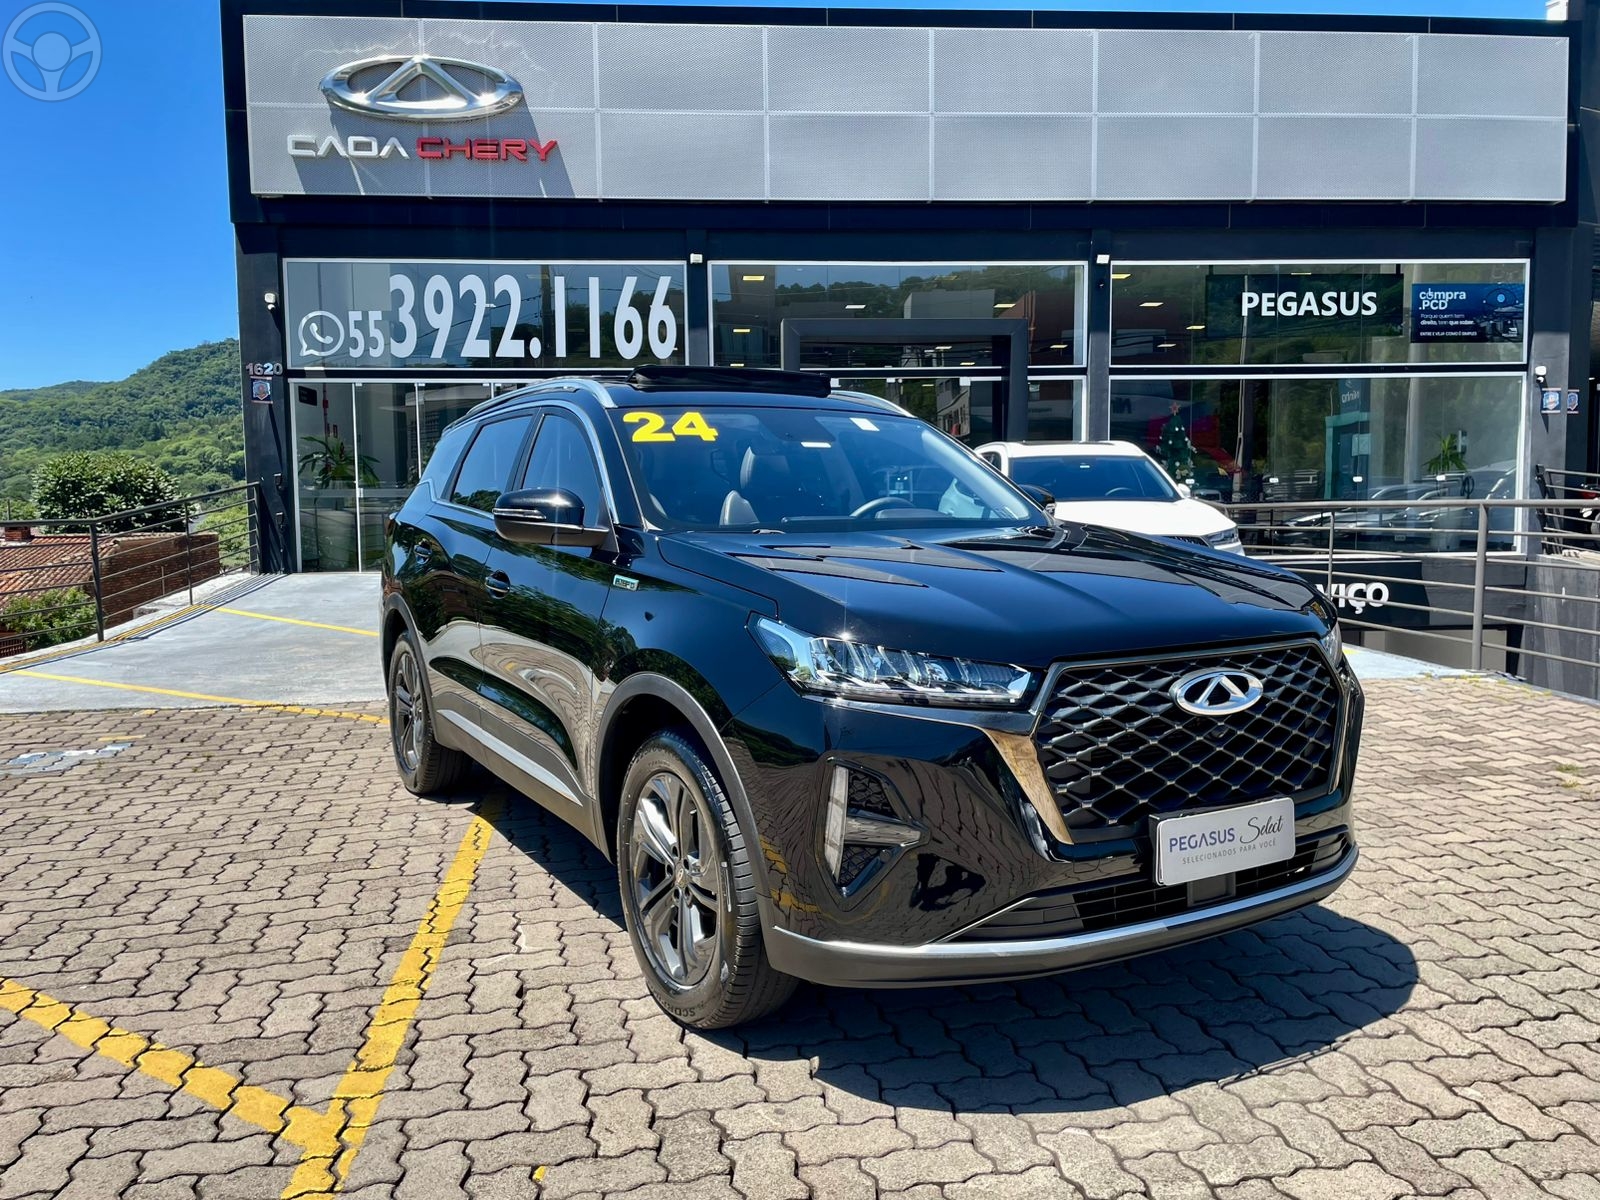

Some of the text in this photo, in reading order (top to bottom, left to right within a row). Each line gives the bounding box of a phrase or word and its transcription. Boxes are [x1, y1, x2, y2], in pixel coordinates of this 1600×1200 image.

[287, 135, 558, 162] CAOA CHERY
[348, 274, 678, 360] 55 3922.1166
[1241, 291, 1378, 317] PEGASUS
[246, 362, 283, 376] 1620
[622, 411, 719, 442] 24
[1169, 815, 1283, 853] PEGASUS Select
[1182, 838, 1277, 865] SELECIONADOS PARA VOCÊ
